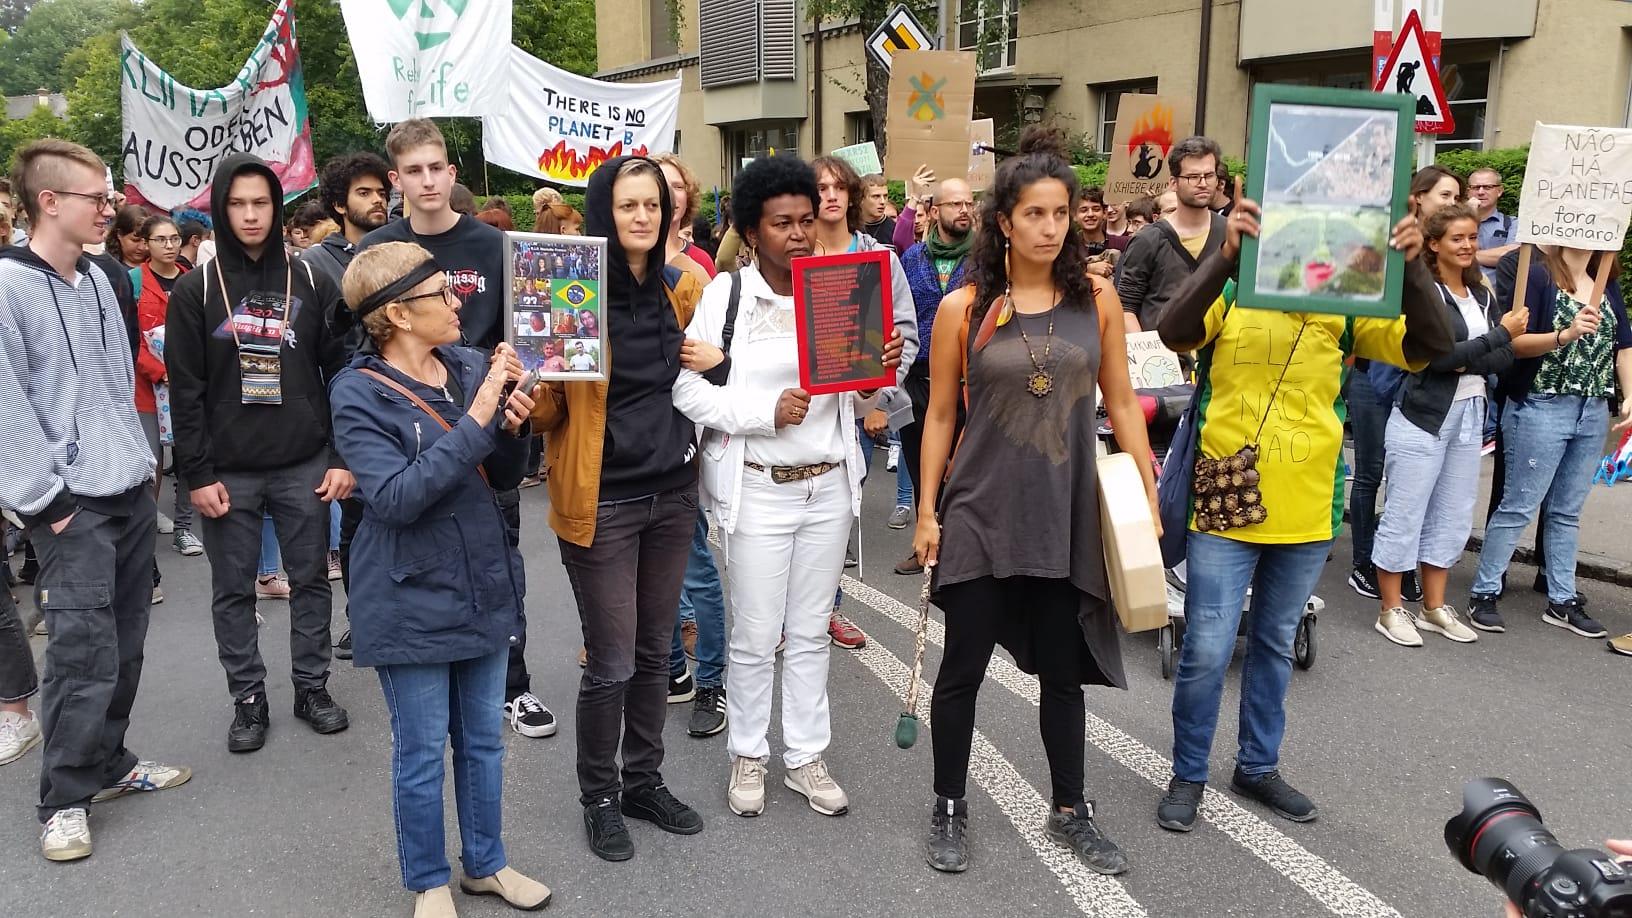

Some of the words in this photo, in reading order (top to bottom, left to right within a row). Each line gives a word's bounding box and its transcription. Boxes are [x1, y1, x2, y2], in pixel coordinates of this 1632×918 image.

[543, 87, 600, 117] THERE
[608, 105, 620, 121] IS
[625, 108, 645, 124] NO
[549, 116, 614, 141] PLANET
[624, 131, 634, 145] B
[1565, 128, 1616, 152] NÃO
[1571, 154, 1601, 176] HÁ
[1114, 181, 1146, 194] SCHIEBE
[1555, 205, 1596, 224] fora
[1531, 221, 1619, 241] bolsonaro!
